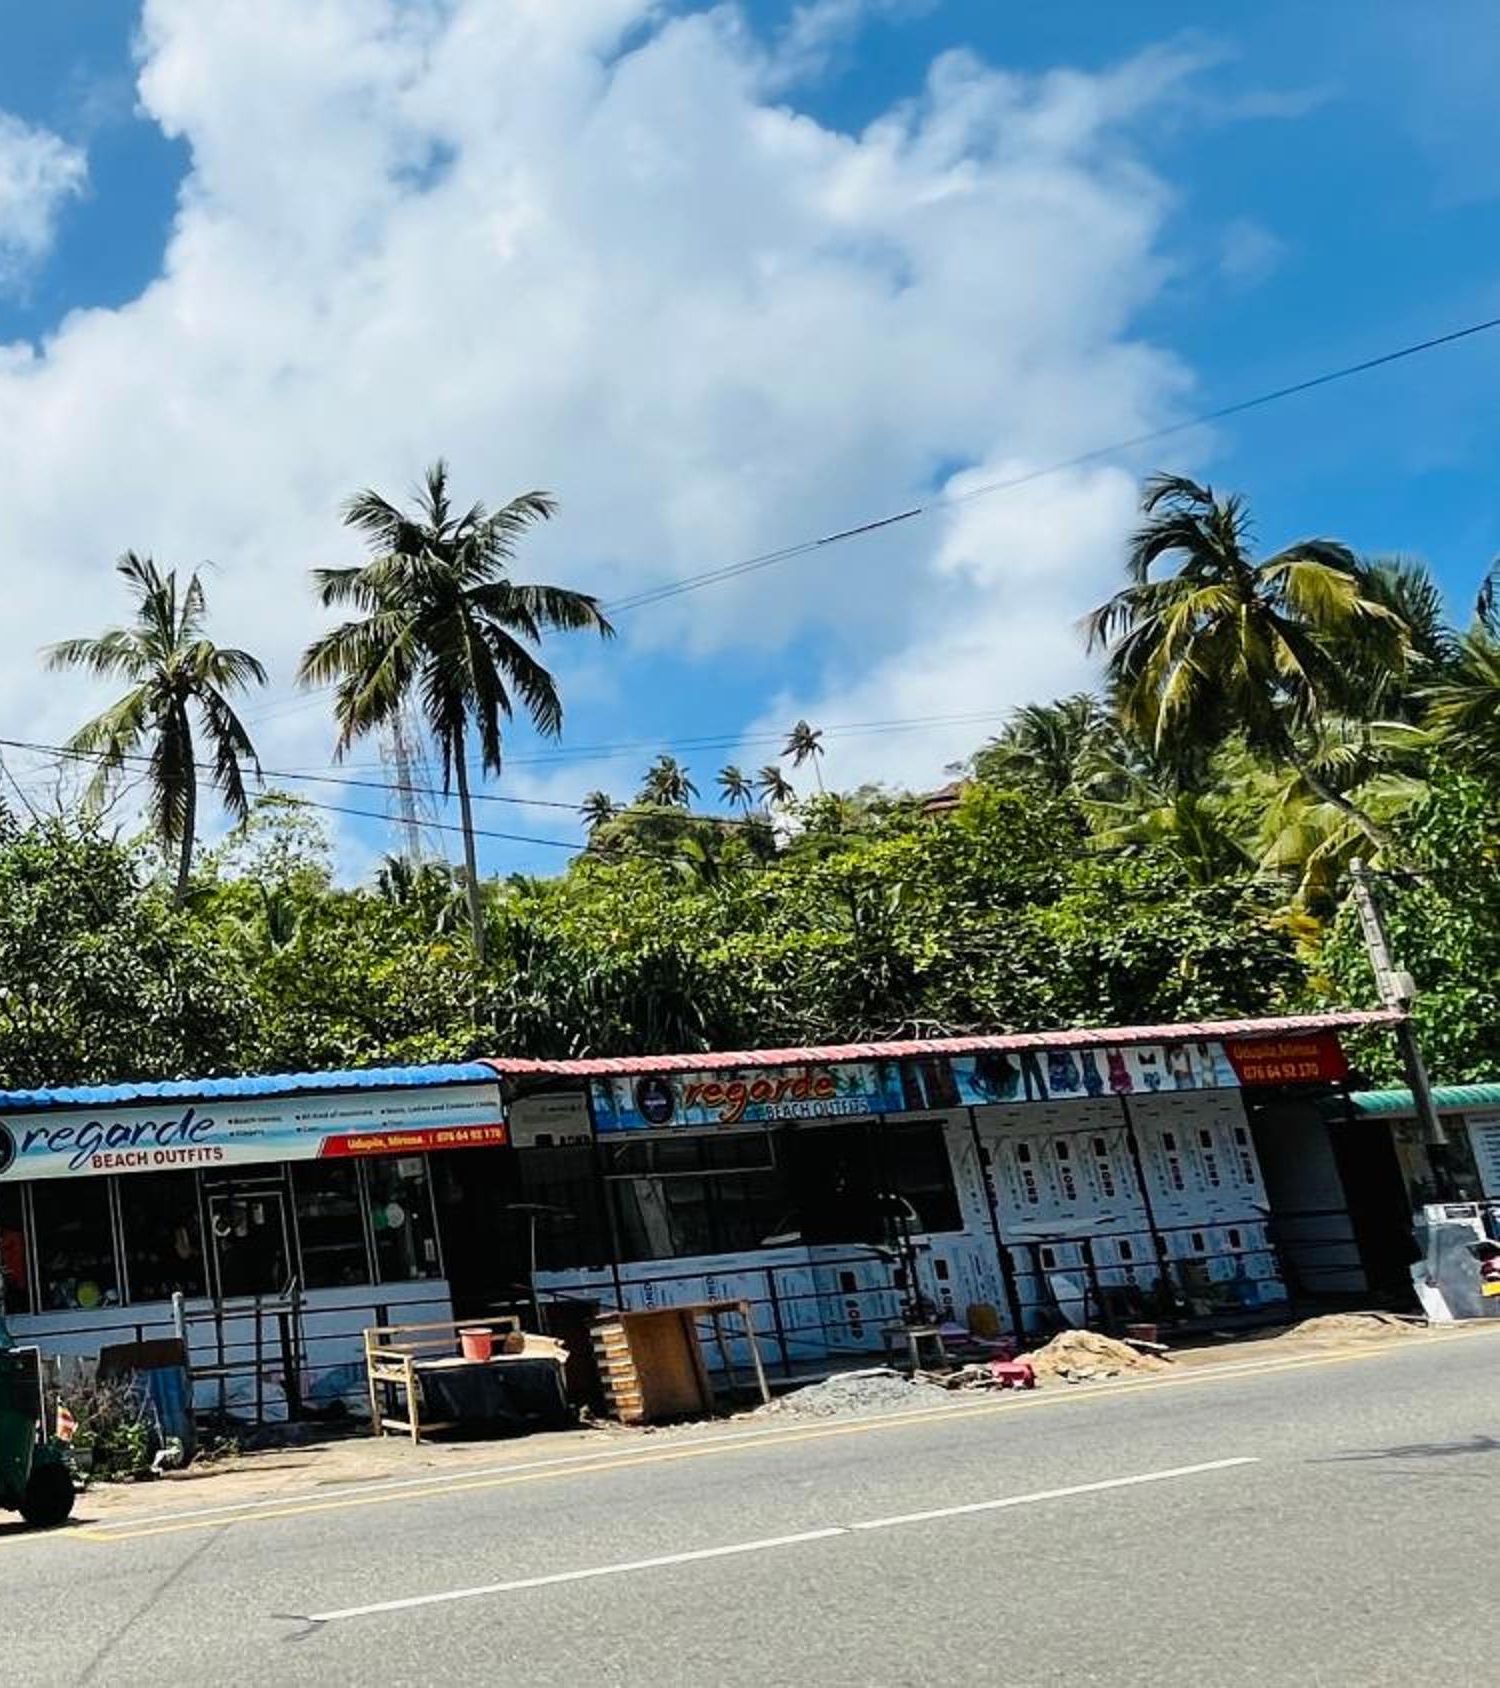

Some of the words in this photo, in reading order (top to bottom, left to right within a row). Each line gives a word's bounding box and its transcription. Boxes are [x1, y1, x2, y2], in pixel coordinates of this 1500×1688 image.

[684, 1071, 836, 1122] regarde
[766, 1102, 809, 1120] BEACH
[814, 1099, 870, 1116] OUTFITS
[21, 1108, 214, 1170] regarde
[92, 1152, 149, 1168] BEACH
[154, 1147, 223, 1164] OUTFITS
